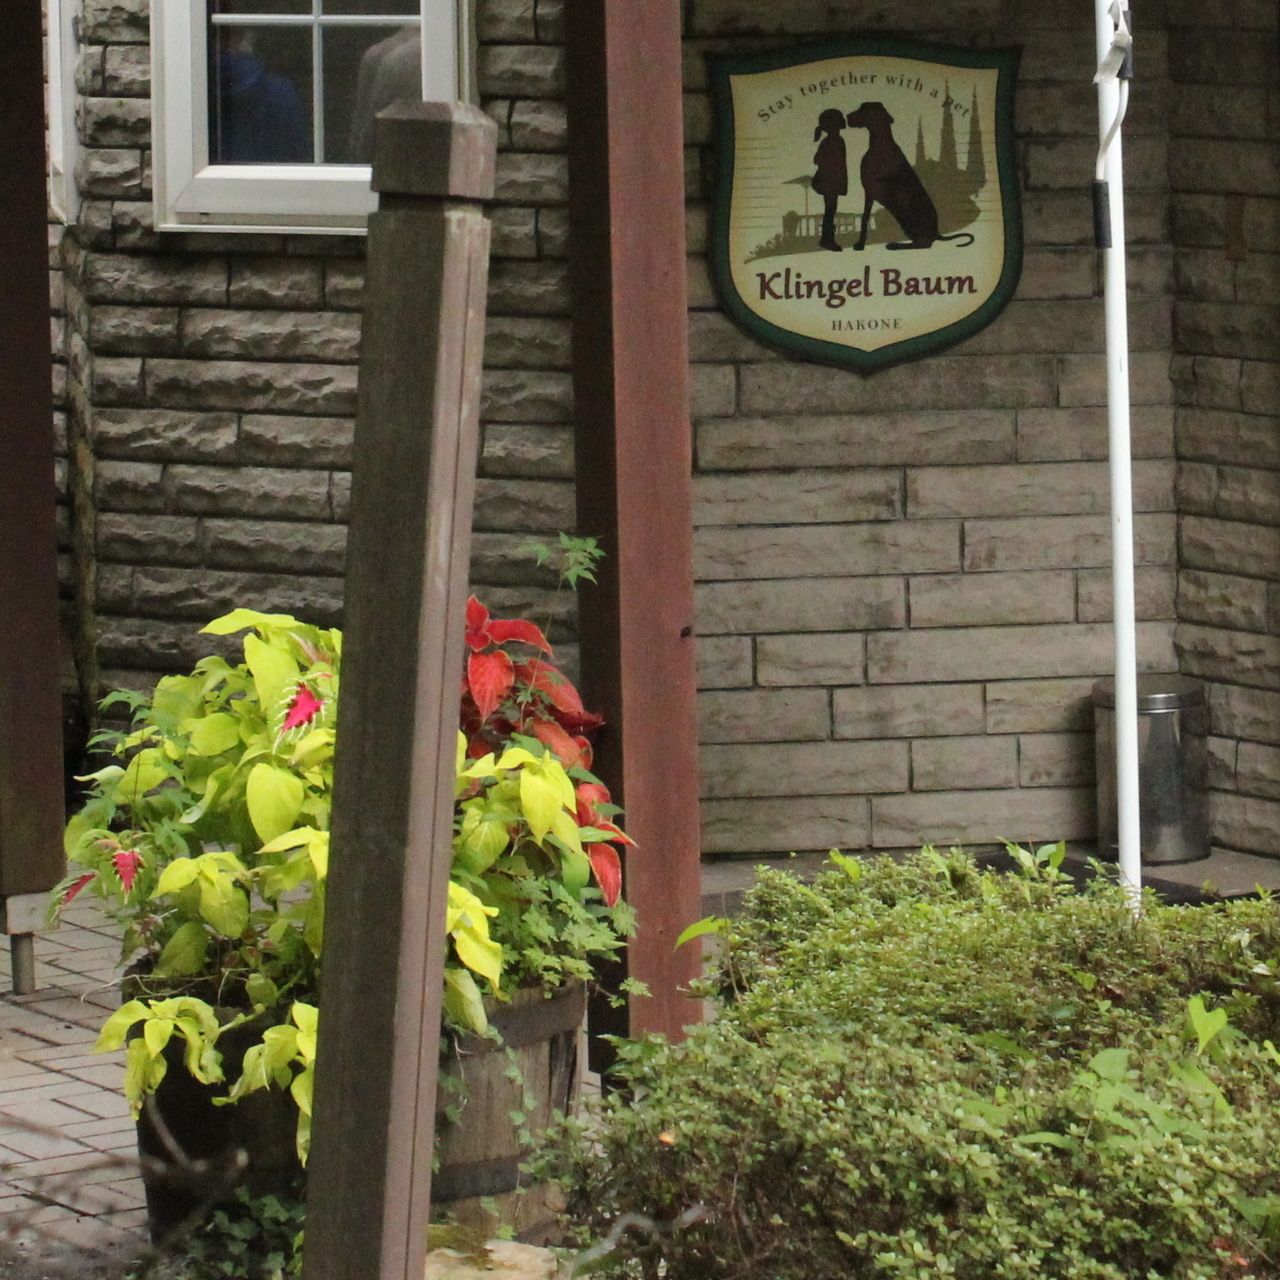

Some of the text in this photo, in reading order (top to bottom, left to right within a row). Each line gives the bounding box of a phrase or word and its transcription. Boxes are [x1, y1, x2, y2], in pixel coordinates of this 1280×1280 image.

[758, 93, 795, 122] Stay
[800, 71, 877, 96] together
[886, 73, 924, 93] with
[930, 88, 939, 99] a
[756, 265, 978, 309] Klingel Baum
[832, 318, 902, 332] HAKONE
